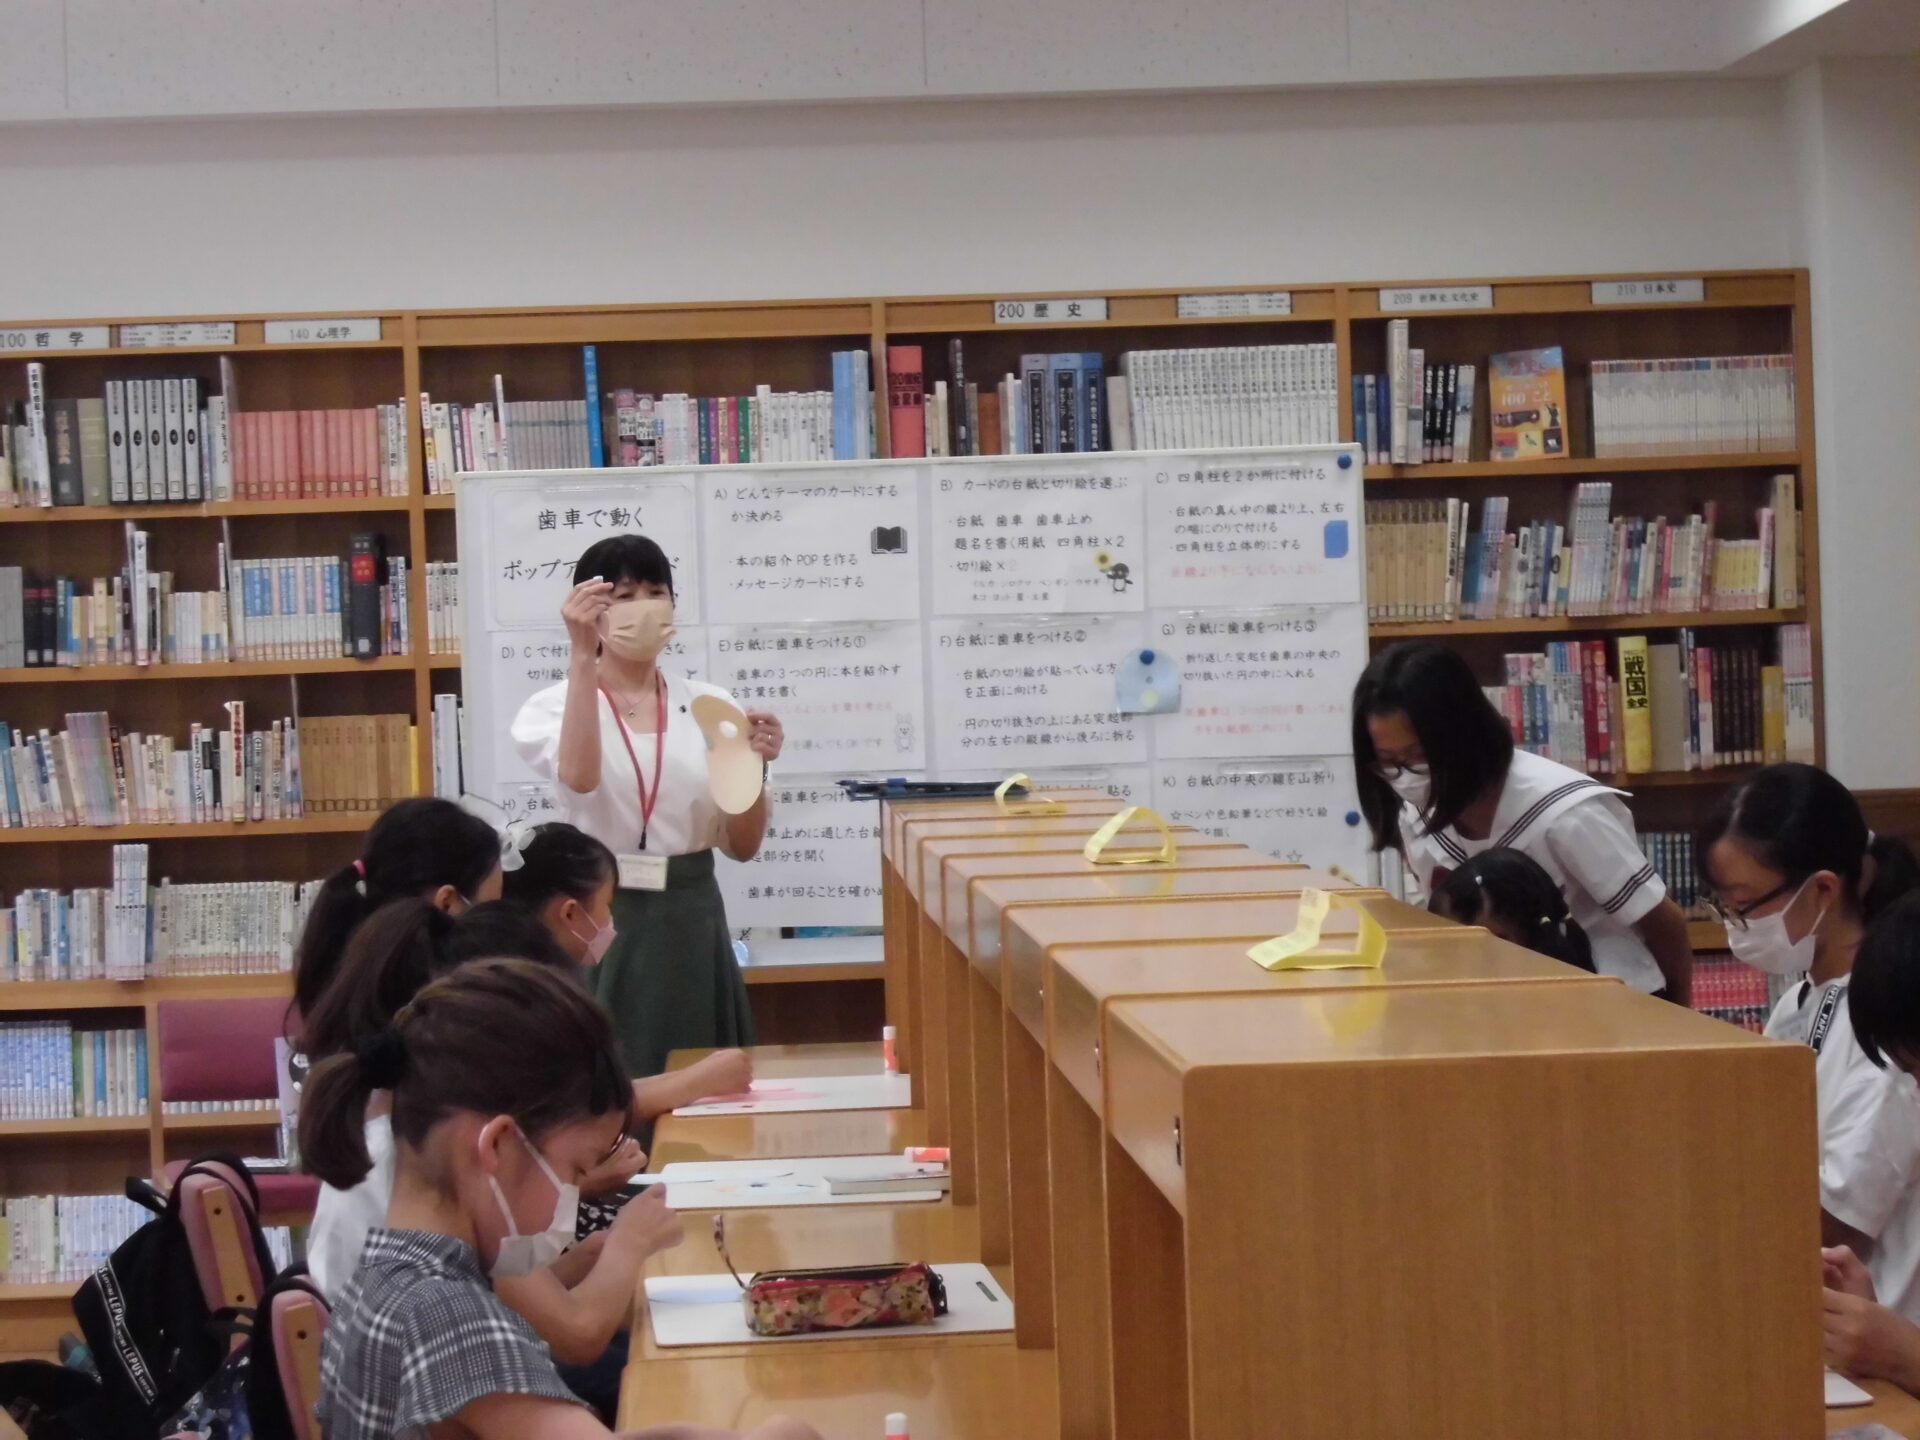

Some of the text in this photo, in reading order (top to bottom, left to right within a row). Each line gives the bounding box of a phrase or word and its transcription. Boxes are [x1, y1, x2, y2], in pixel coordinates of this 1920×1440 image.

[998, 303, 1025, 318] 200
[290, 326, 352, 340] 140 心理学
[0, 333, 26, 348] 100
[736, 484, 899, 499] どんなテーマのカードにする
[538, 506, 644, 530] 歯車で動く
[731, 510, 784, 523] か決める
[996, 514, 1024, 527] 歯車
[1036, 513, 1093, 526] 歯車止め
[731, 686, 799, 699] る言葉を書く
[965, 684, 1048, 698] を正面に向ける
[122, 1347, 144, 1376] LEPUS
